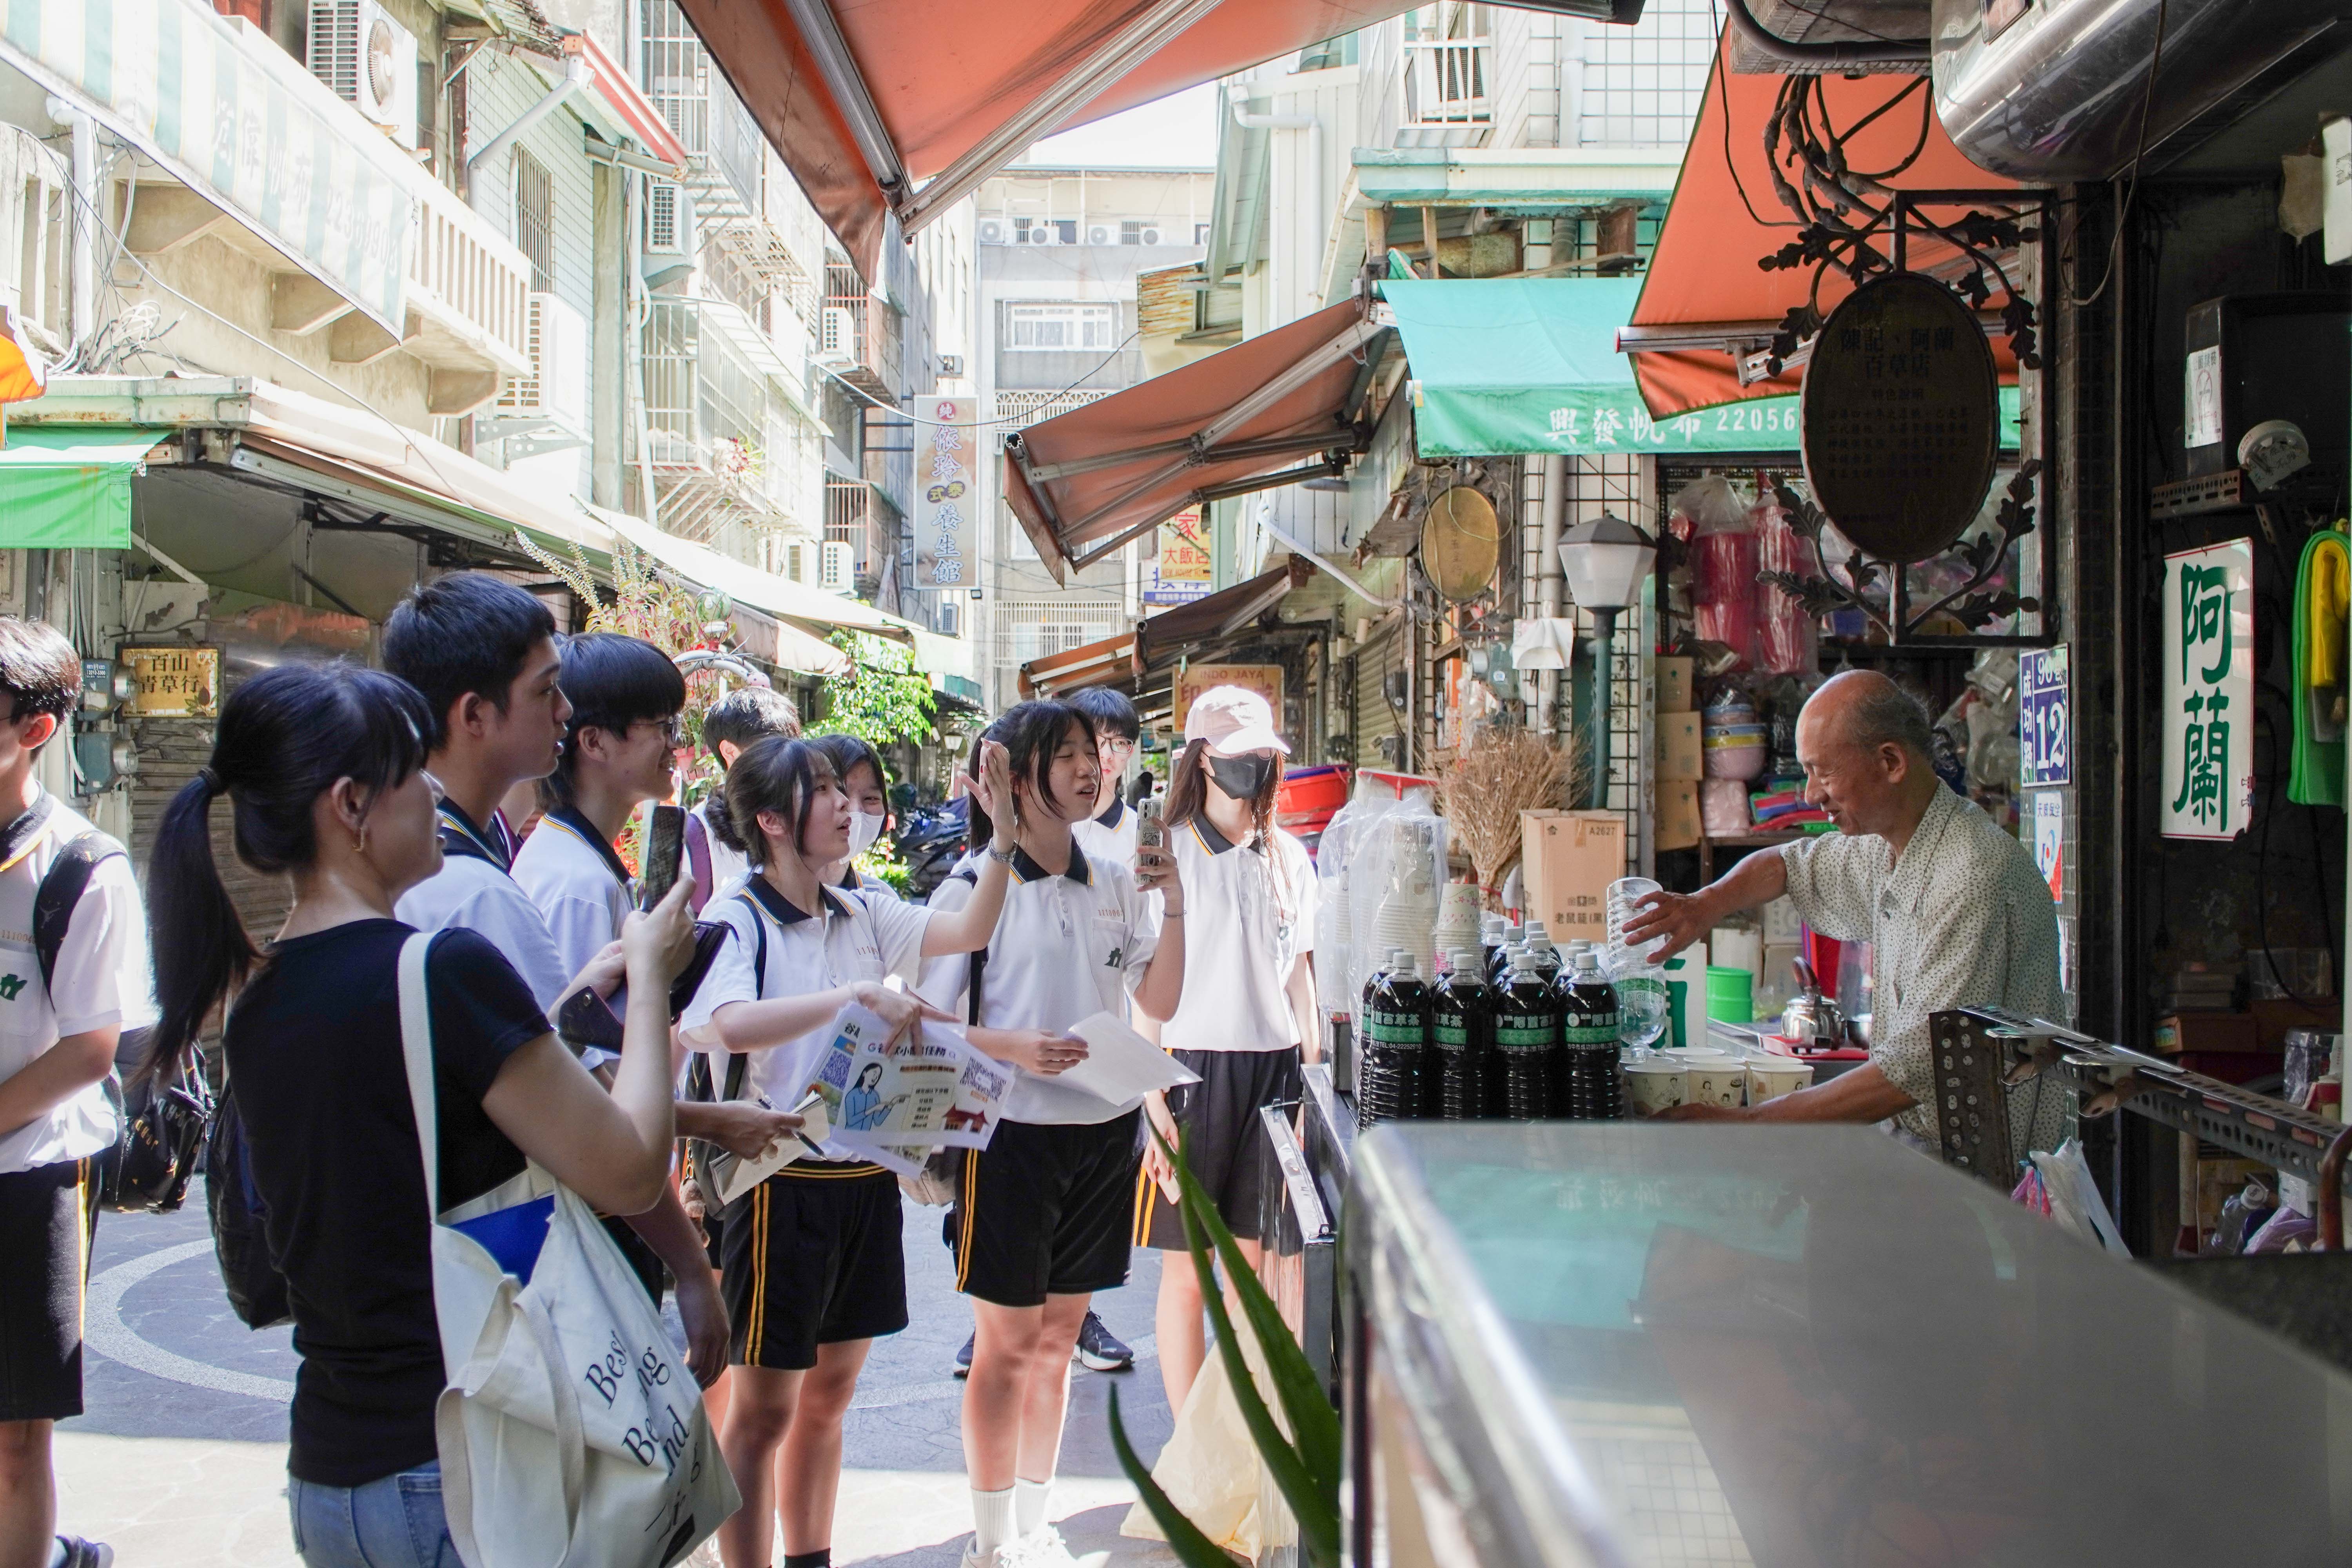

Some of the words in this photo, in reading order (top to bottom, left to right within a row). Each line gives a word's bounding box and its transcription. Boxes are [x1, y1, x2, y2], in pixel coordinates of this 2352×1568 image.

[1164, 546, 1210, 564] 大飯店
[151, 653, 188, 671] 百山
[1200, 670, 1228, 679] INDO
[1234, 670, 1264, 679] JAYA
[140, 675, 199, 694] 青草行
[2172, 561, 2234, 832] 阿蘭
[2022, 670, 2033, 770] 成功路
[2036, 702, 2066, 770] 12
[1589, 826, 1615, 836] A2627
